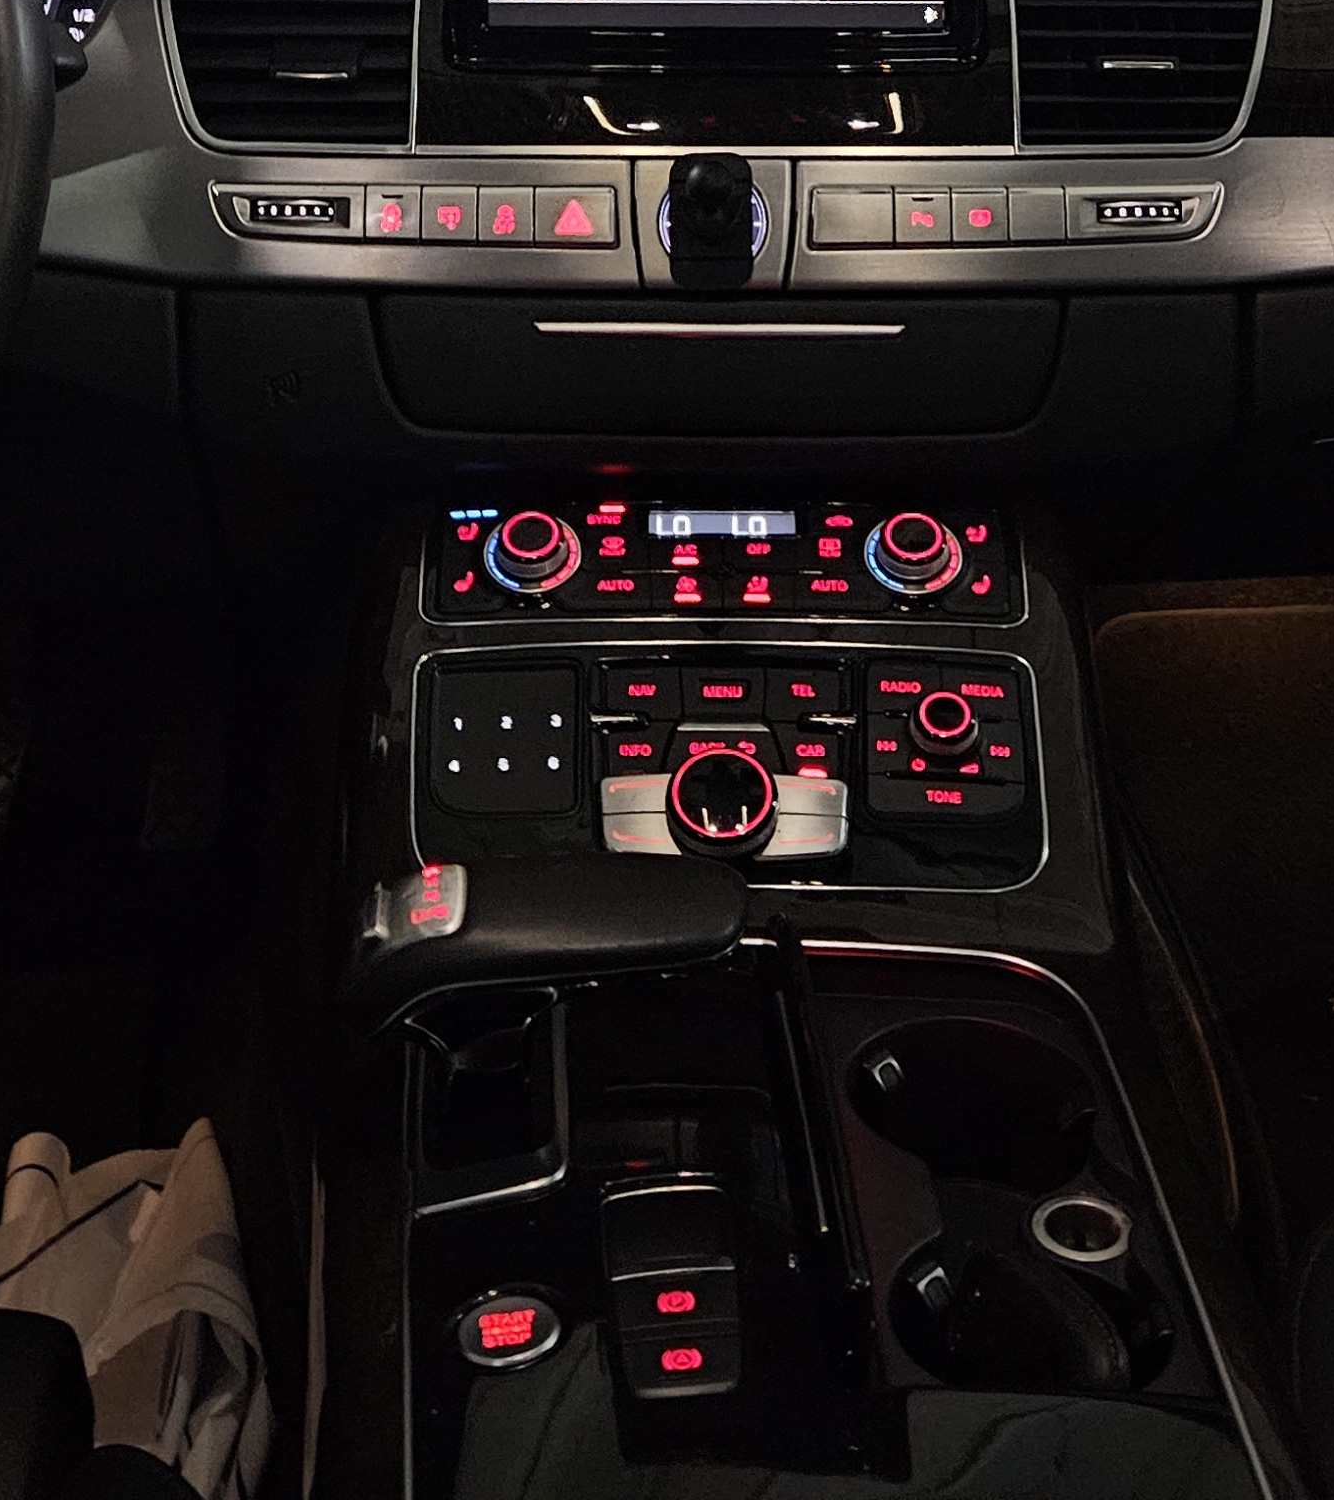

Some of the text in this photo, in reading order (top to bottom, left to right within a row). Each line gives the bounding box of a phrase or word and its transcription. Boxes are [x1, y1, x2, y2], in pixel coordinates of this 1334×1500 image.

[673, 543, 698, 556] A/C
[597, 579, 635, 592] AUTO
[810, 579, 849, 592] AUTO
[628, 683, 657, 697] NAV
[702, 684, 743, 698] MENU
[791, 683, 816, 698] TEL
[880, 680, 922, 694] RADIO
[961, 683, 1005, 698] MEDIA
[453, 713, 563, 731] 1 2 3
[619, 743, 653, 757] INFO
[795, 743, 826, 757] CAR
[925, 789, 963, 804] TONE
[479, 1309, 536, 1329] START
[482, 1331, 532, 1349] STOP
